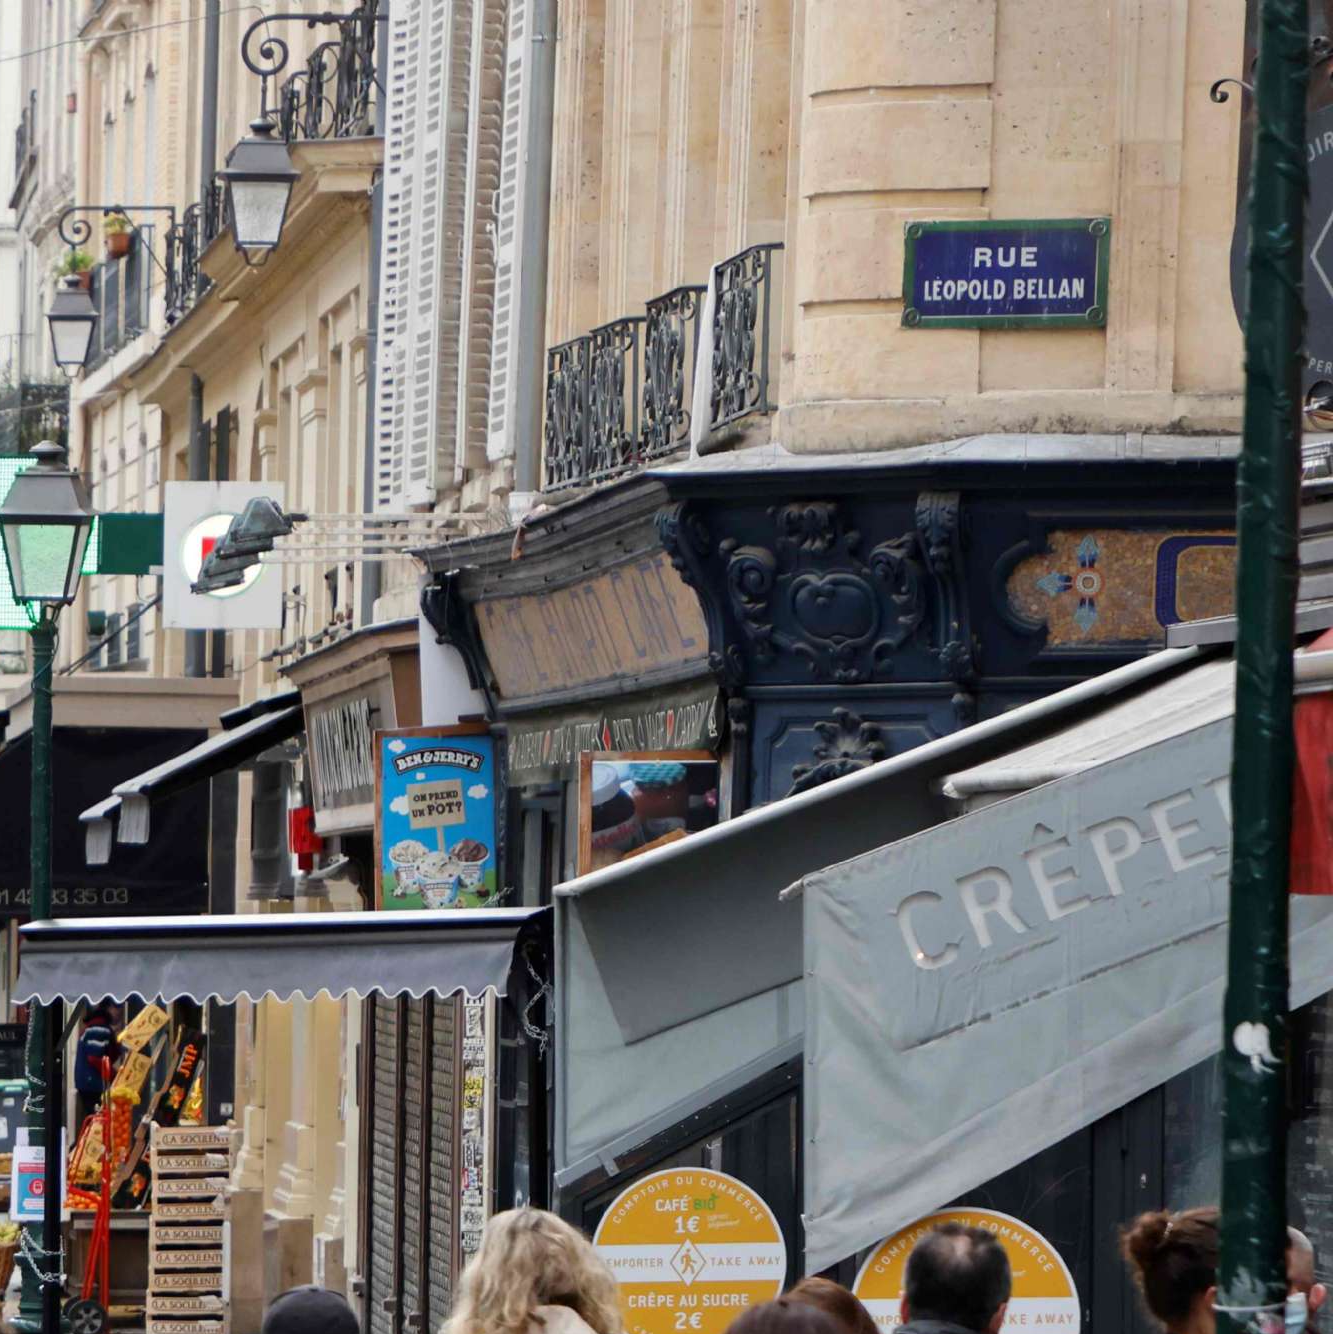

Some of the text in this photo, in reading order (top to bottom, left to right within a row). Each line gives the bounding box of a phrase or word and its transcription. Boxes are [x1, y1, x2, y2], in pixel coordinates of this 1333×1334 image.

[974, 246, 1038, 268] RUE
[923, 276, 1085, 301] LÉOPOLD BELLAN
[413, 789, 459, 803] ON PREND
[427, 801, 463, 817] POT?
[895, 773, 1234, 971] CRÊPE
[73, 887, 97, 905] 35
[102, 887, 129, 904] 03
[178, 1043, 198, 1079] JMP
[612, 1176, 764, 1224] COMPTOIR DU COMMERCE
[655, 1194, 689, 1212] CAFÉ
[674, 1215, 700, 1233] 1€
[873, 1223, 933, 1274] COMPTO
[978, 1218, 1055, 1273] COMMERCE
[710, 1256, 742, 1266] TAKE
[748, 1256, 781, 1266] AWAY
[628, 1291, 749, 1308] CRÊPE AU SUCRE
[674, 1312, 703, 1329] 2€
[1035, 1313, 1074, 1325] AWAY
